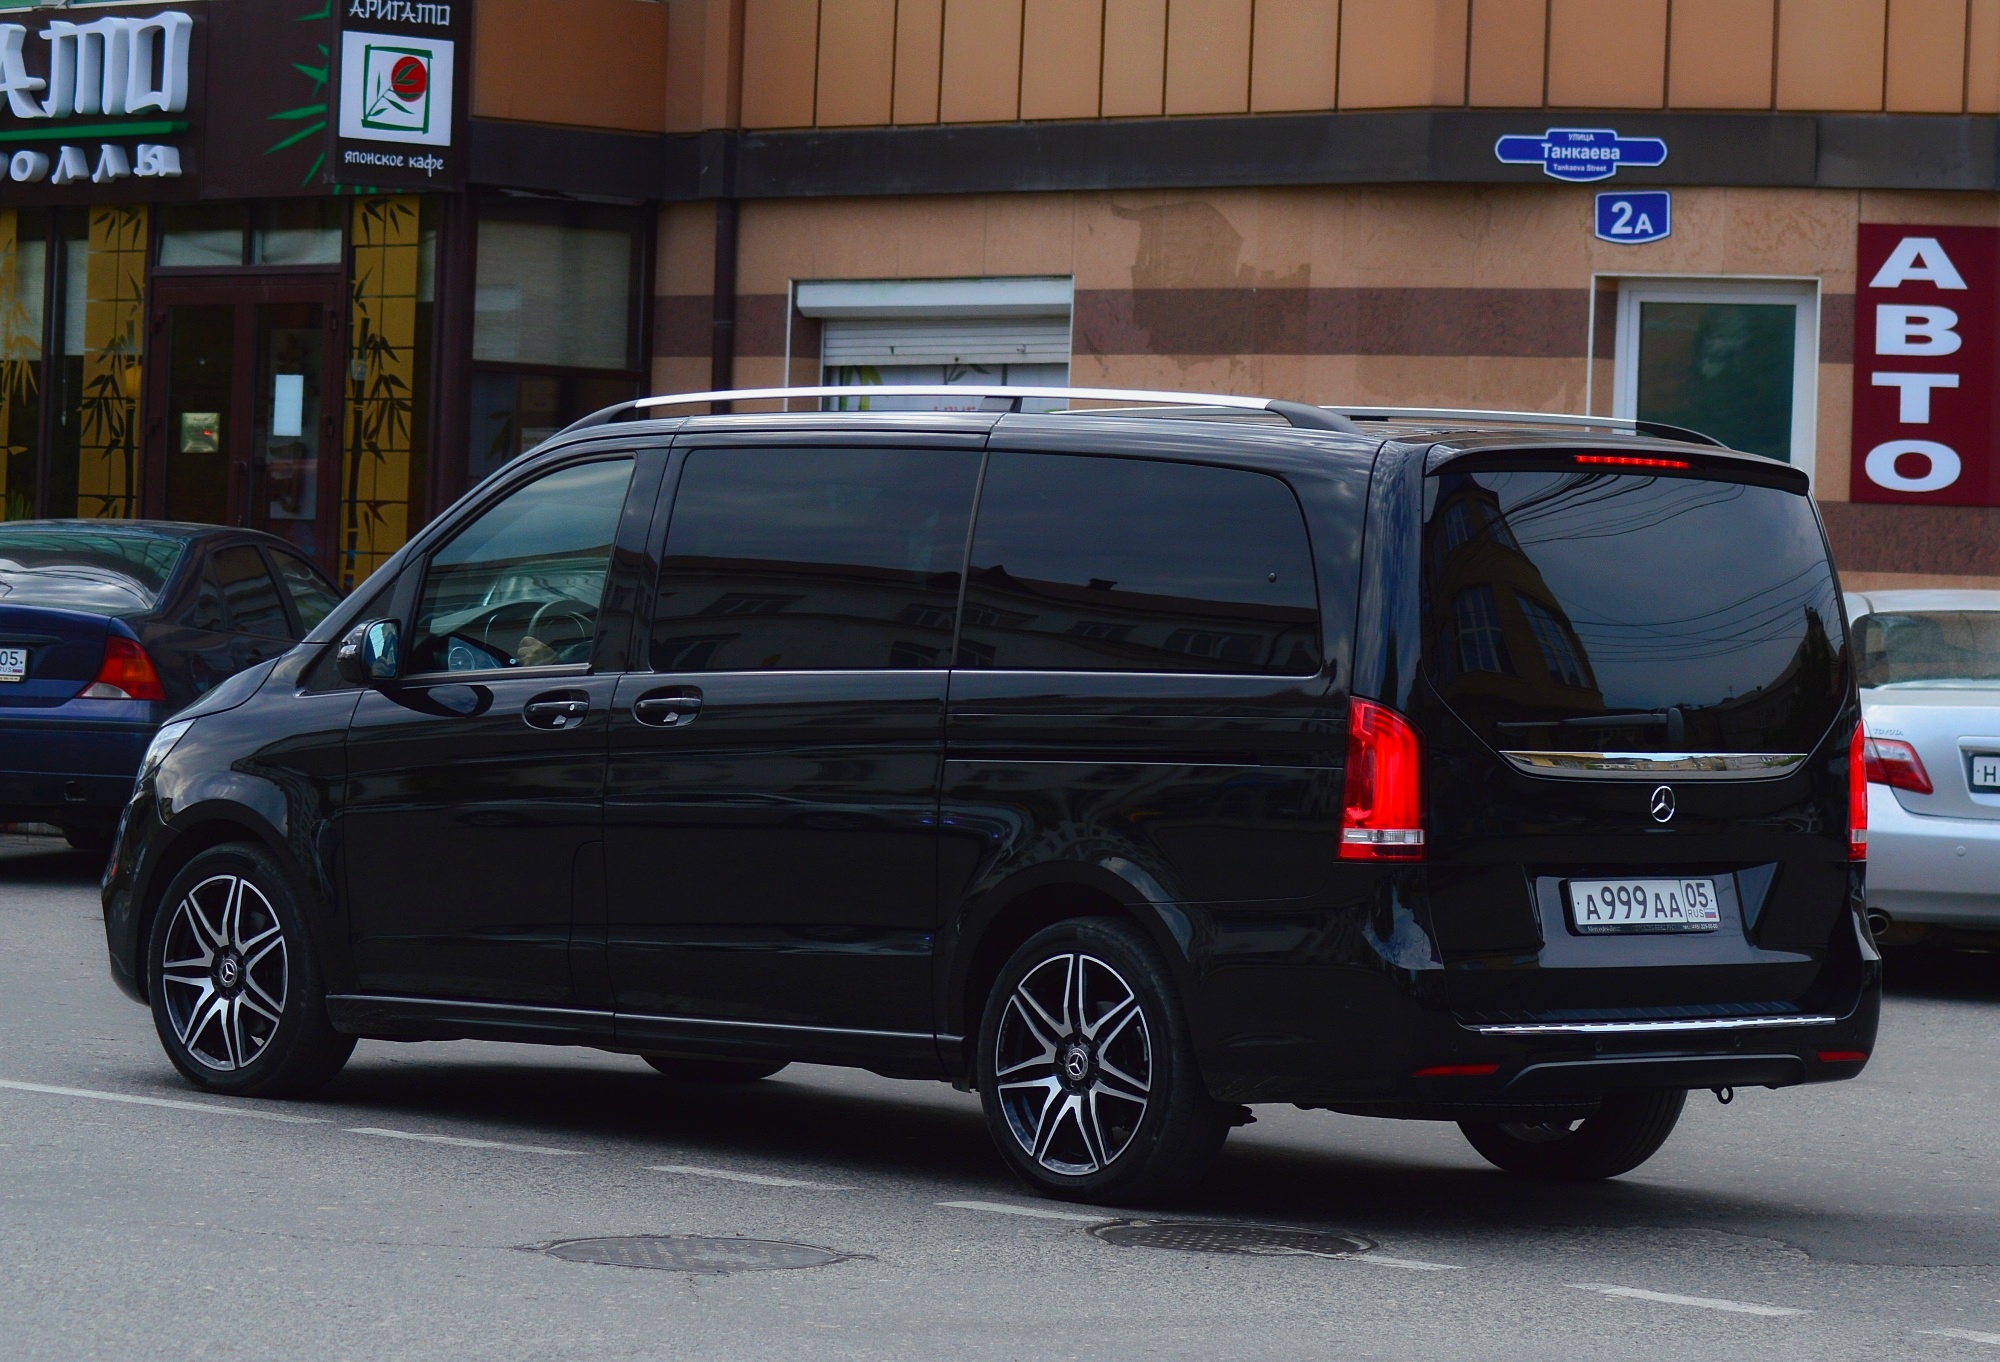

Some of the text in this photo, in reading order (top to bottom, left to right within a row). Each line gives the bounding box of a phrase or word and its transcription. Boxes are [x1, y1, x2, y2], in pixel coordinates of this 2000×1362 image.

[349, 0, 451, 26] АРИГАТО
[1568, 133, 1595, 142] УЛИЦА
[1541, 142, 1621, 160] Танкаева
[344, 150, 444, 178] японское кафе
[1553, 163, 1607, 172] Tankaeva Street
[1610, 201, 1654, 235] 2А
[1865, 236, 1968, 493] АВТО
[0, 650, 19, 666] 05
[1685, 882, 1709, 908] 05
[1688, 909, 1704, 918] RUS
